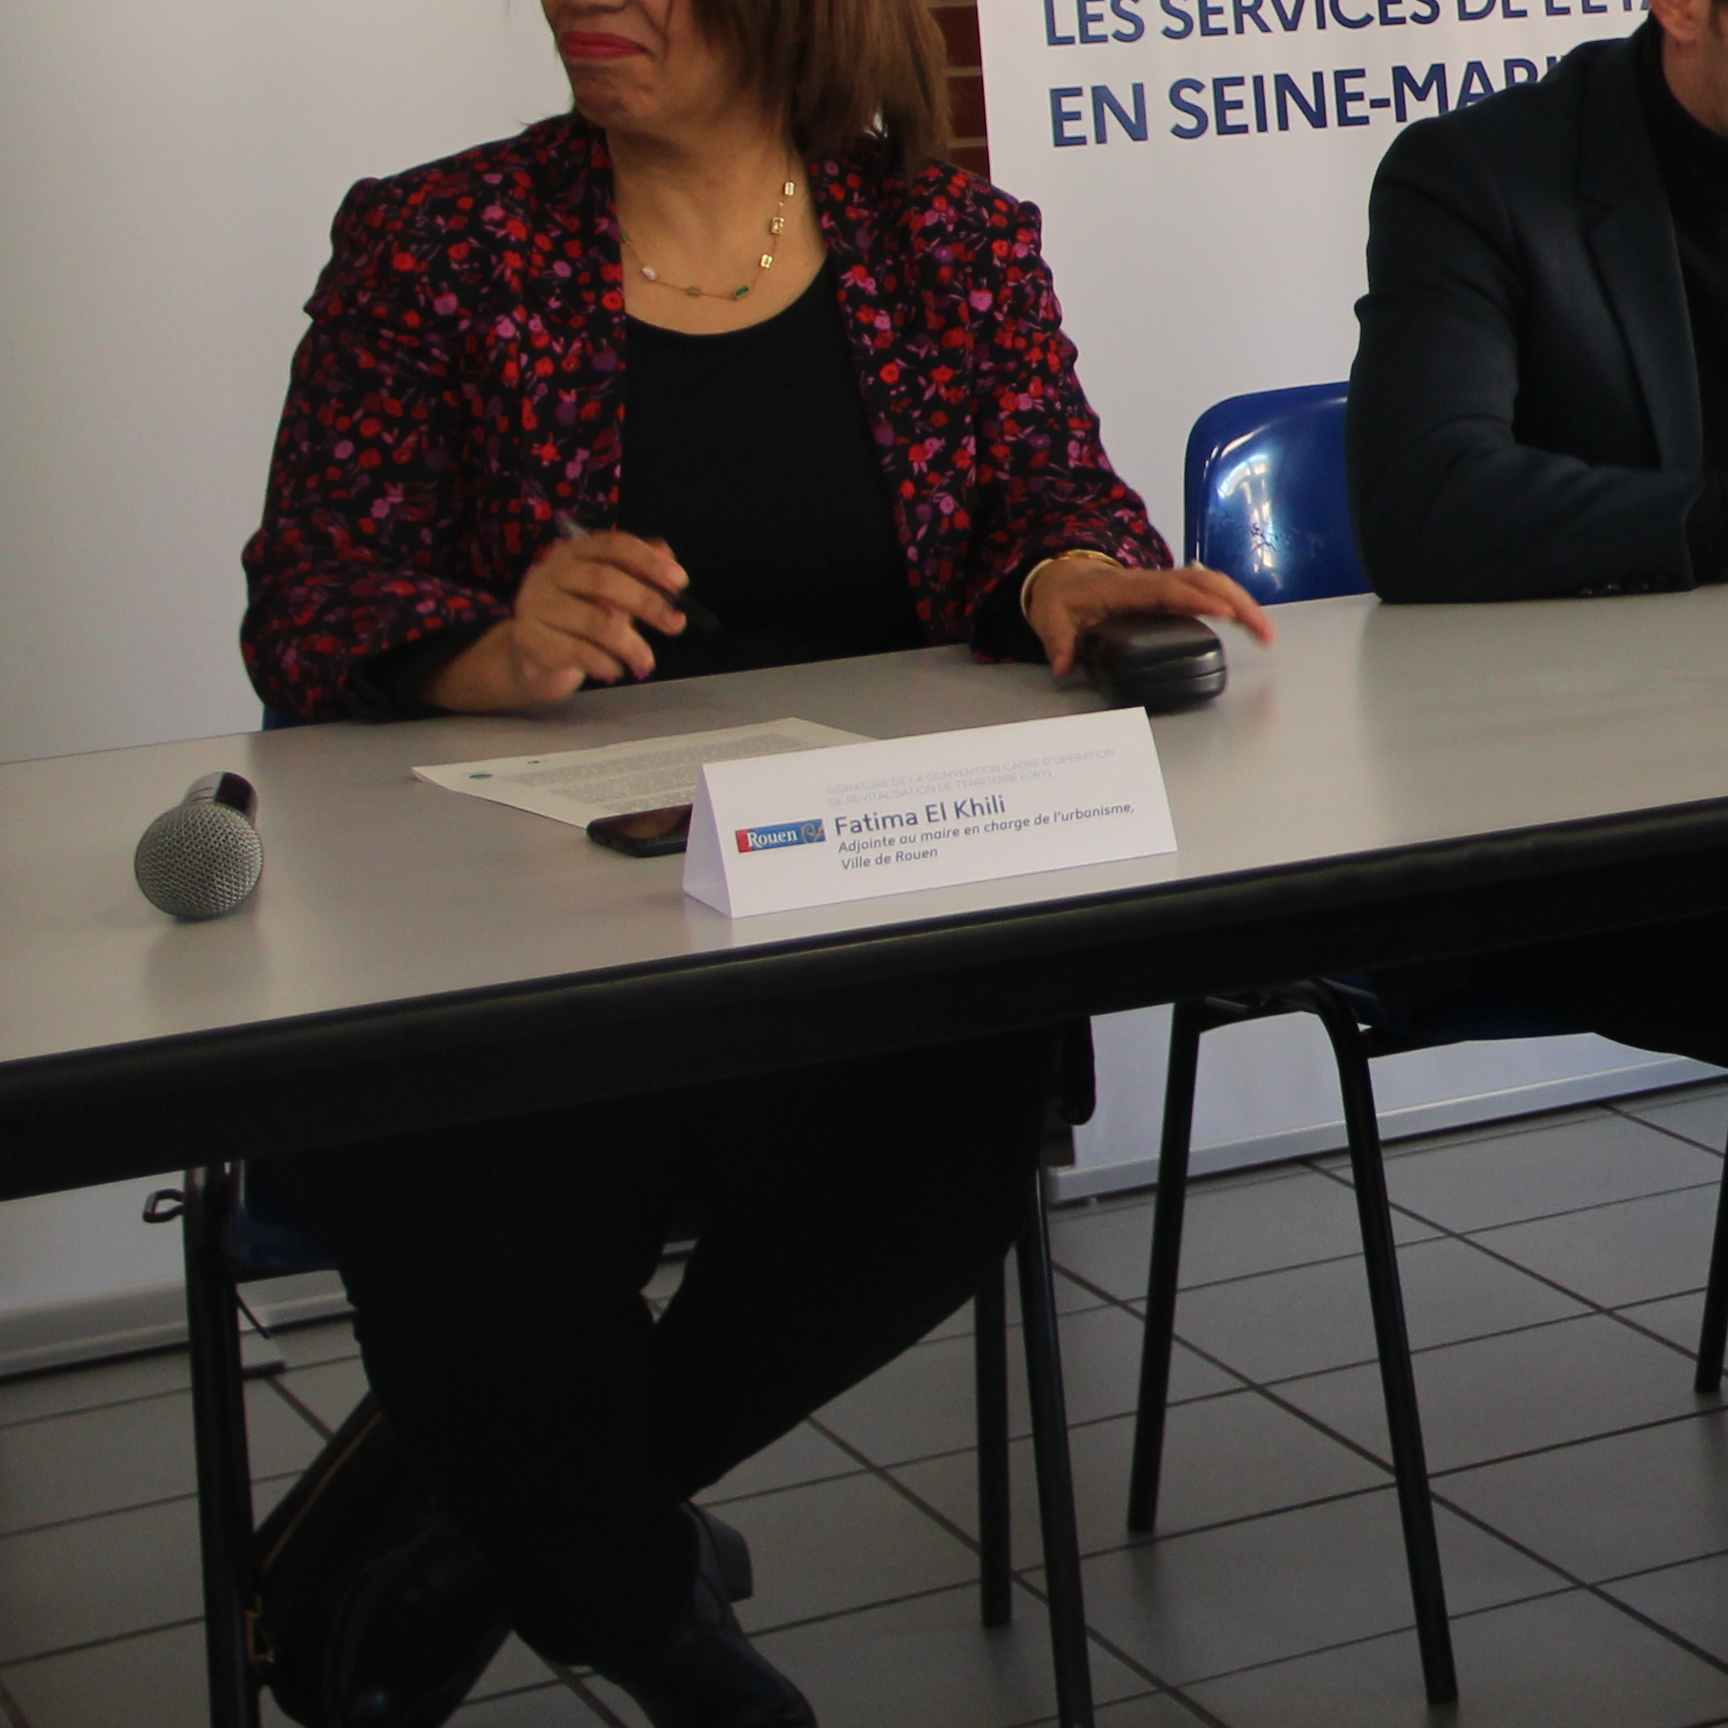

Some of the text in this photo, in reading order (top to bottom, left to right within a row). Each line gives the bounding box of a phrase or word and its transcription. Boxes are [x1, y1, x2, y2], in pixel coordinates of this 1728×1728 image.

[1050, 82, 1149, 147] EN
[834, 794, 1006, 836] Fatima El Khili
[837, 801, 1135, 854] Adjointe au maire en charge de l'urbanisme,
[746, 826, 798, 850] Rouen
[841, 846, 938, 870] Ville de Rouen
